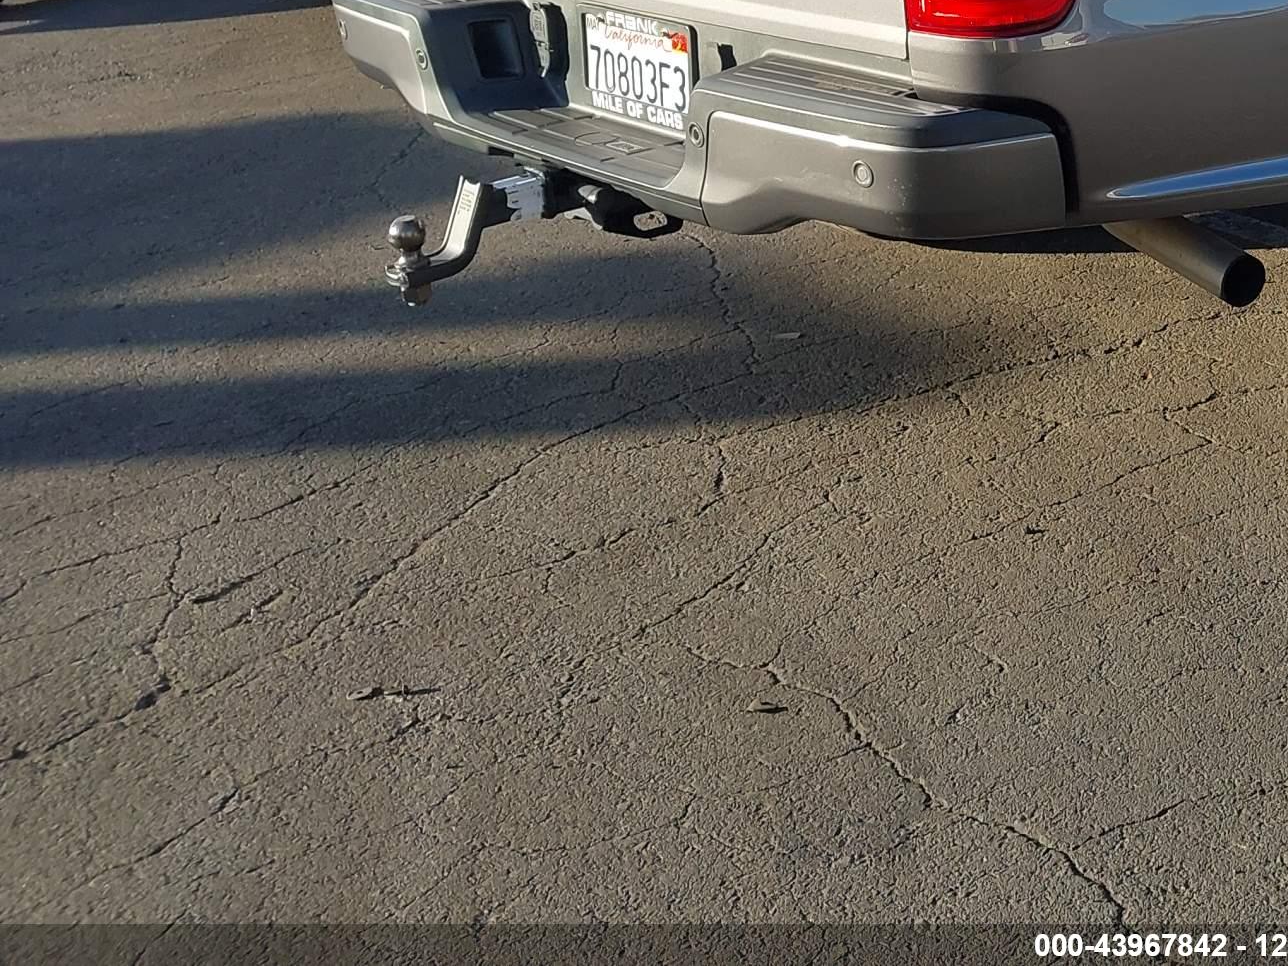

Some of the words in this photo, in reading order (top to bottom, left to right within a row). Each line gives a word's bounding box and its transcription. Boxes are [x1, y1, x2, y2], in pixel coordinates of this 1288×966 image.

[604, 25, 672, 52] California
[590, 44, 687, 113] 70803F3
[592, 90, 624, 114] MILE
[626, 100, 644, 120] OF
[646, 106, 685, 130] CARS
